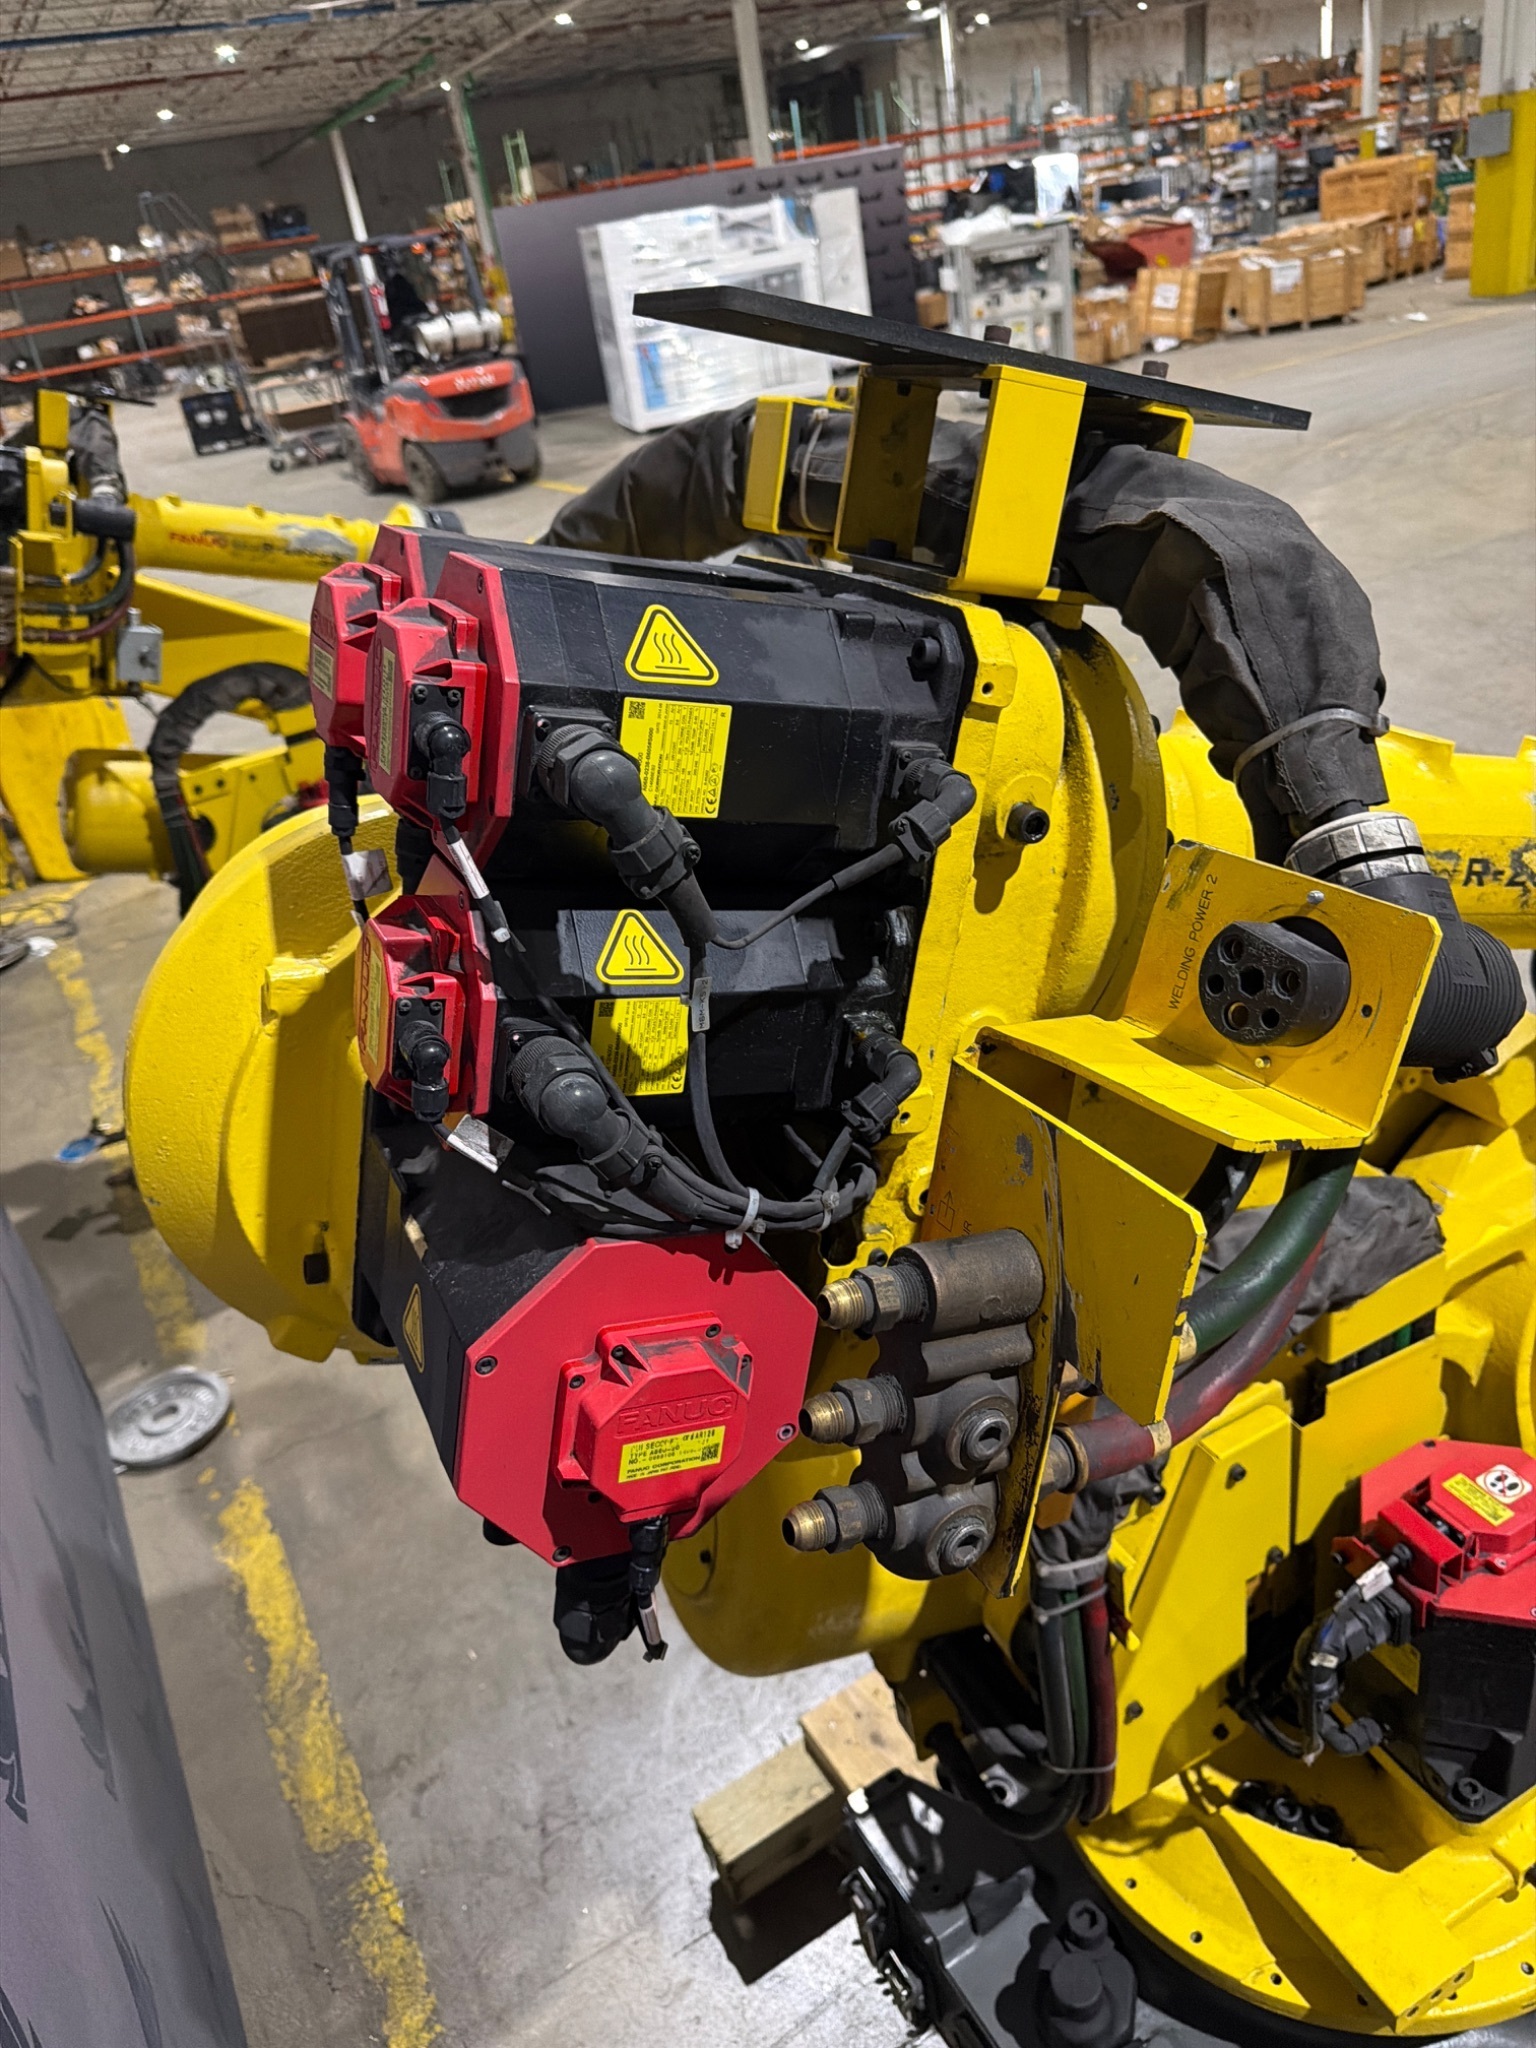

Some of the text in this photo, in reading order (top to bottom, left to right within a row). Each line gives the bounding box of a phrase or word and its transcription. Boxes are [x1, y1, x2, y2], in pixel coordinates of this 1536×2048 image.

[1168, 874, 1218, 1010] WELDING POWER 2
[617, 1395, 733, 1434] FANUC
